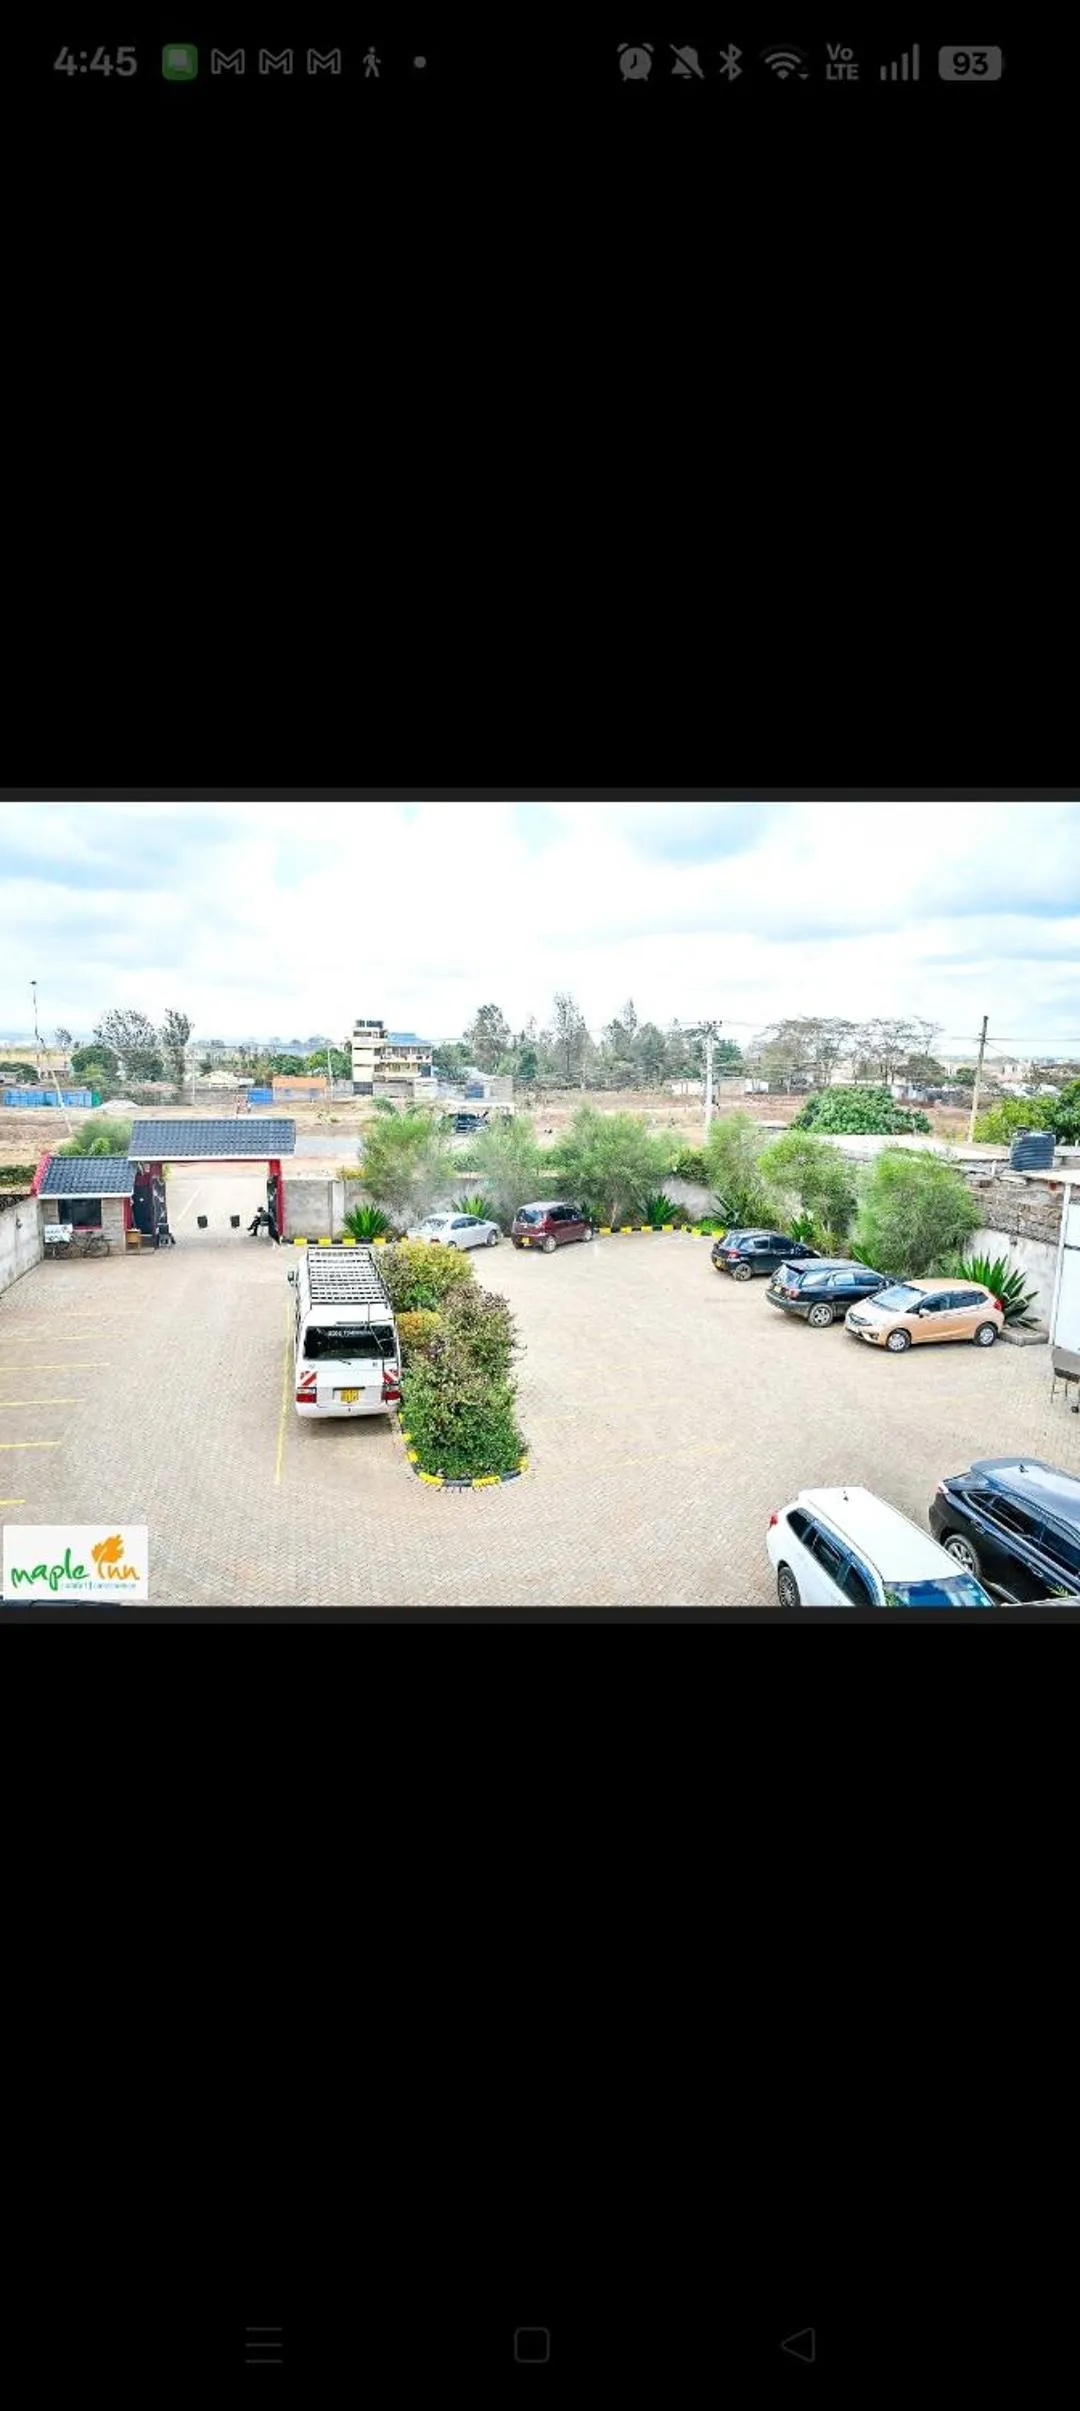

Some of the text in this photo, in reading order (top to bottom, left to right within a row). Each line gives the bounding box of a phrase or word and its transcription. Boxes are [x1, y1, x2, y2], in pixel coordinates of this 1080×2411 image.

[54, 47, 137, 76] 4:45
[827, 44, 854, 60] Vo
[826, 64, 858, 80] LTE
[953, 52, 988, 75] 93
